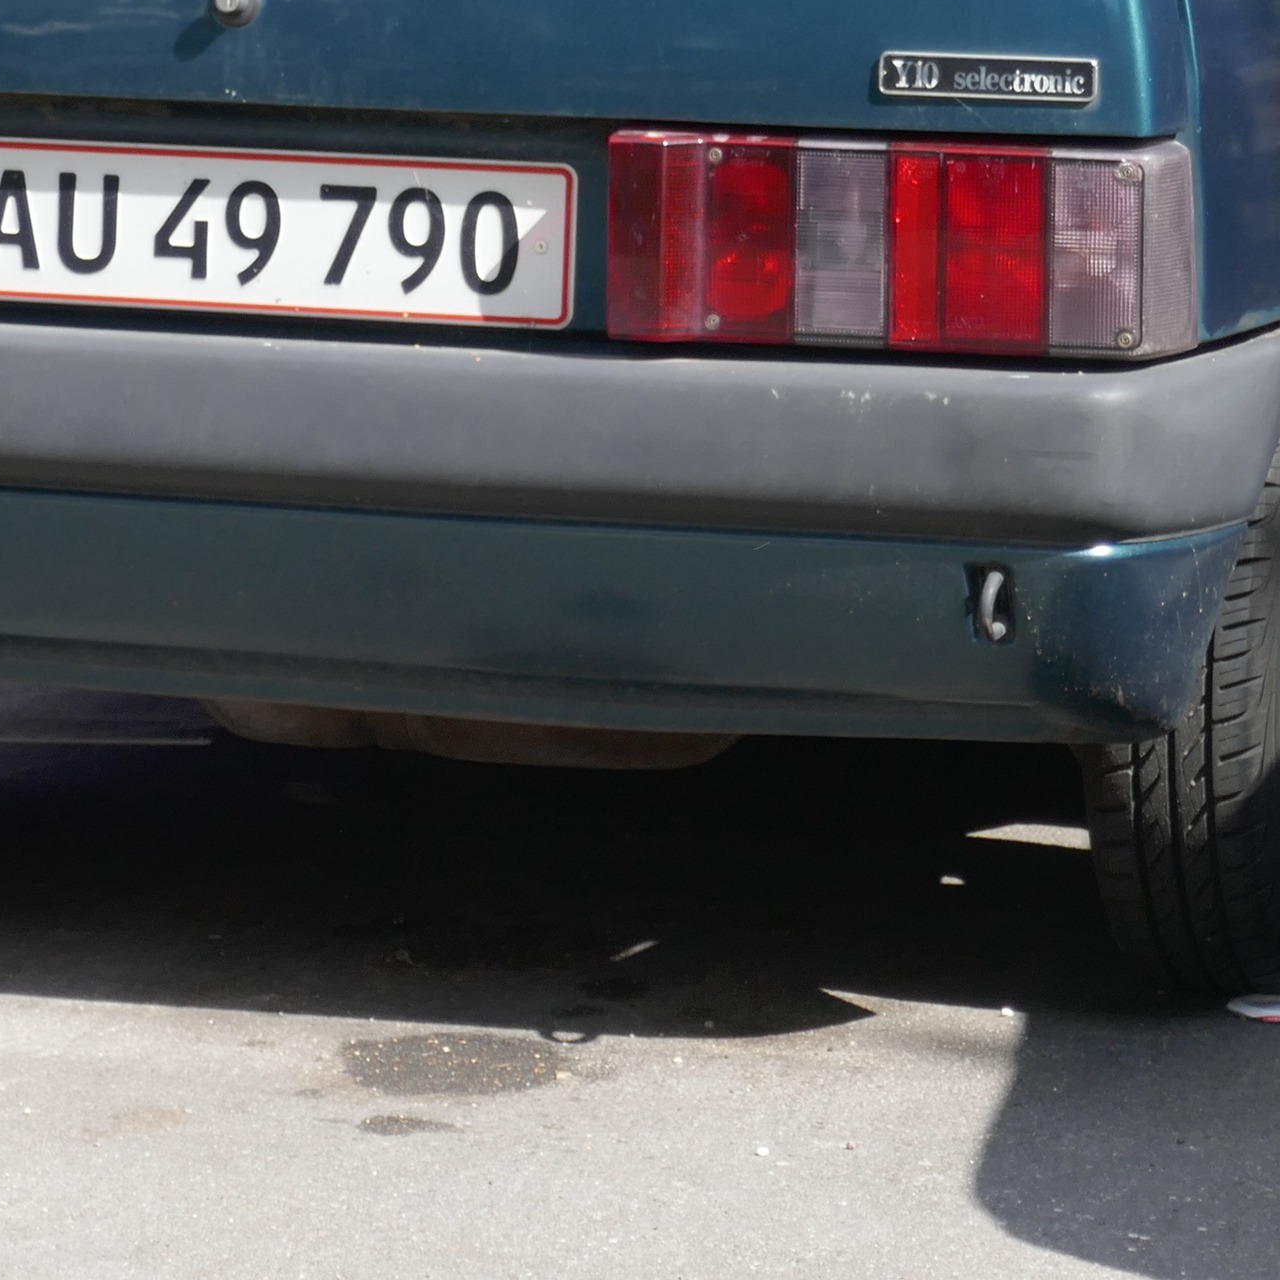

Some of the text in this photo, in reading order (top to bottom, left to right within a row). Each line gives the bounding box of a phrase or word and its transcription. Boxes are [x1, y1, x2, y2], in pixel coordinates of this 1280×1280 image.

[891, 58, 1085, 95] Y10 selectronic
[153, 177, 281, 286] 49
[319, 183, 520, 296] 790
